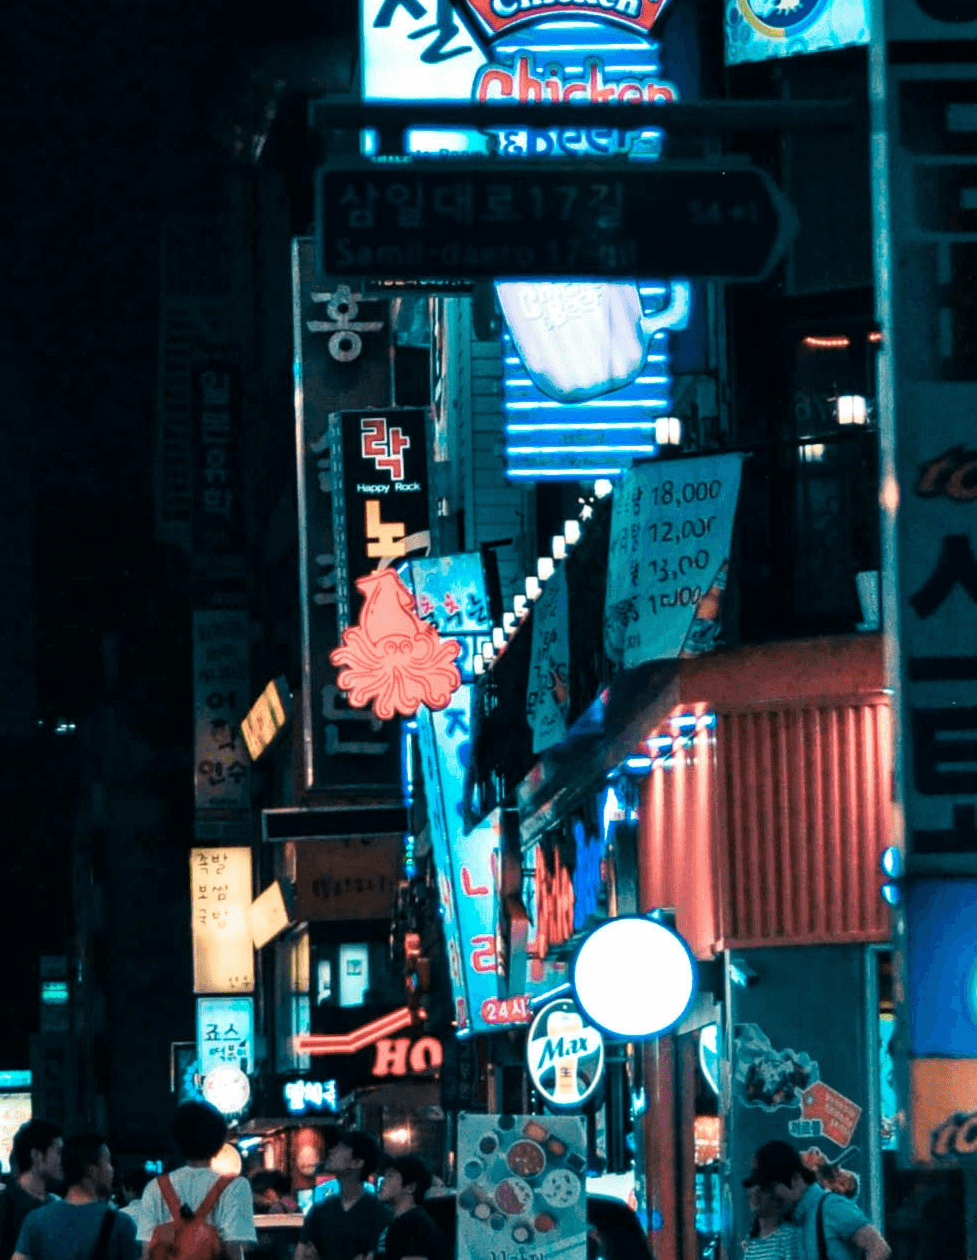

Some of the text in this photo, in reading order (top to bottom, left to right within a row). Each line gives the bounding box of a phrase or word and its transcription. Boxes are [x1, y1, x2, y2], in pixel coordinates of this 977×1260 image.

[361, 418, 410, 481] 락
[357, 482, 422, 495] Happy Rock
[651, 480, 722, 508] 18,000
[537, 1037, 588, 1070] Max
